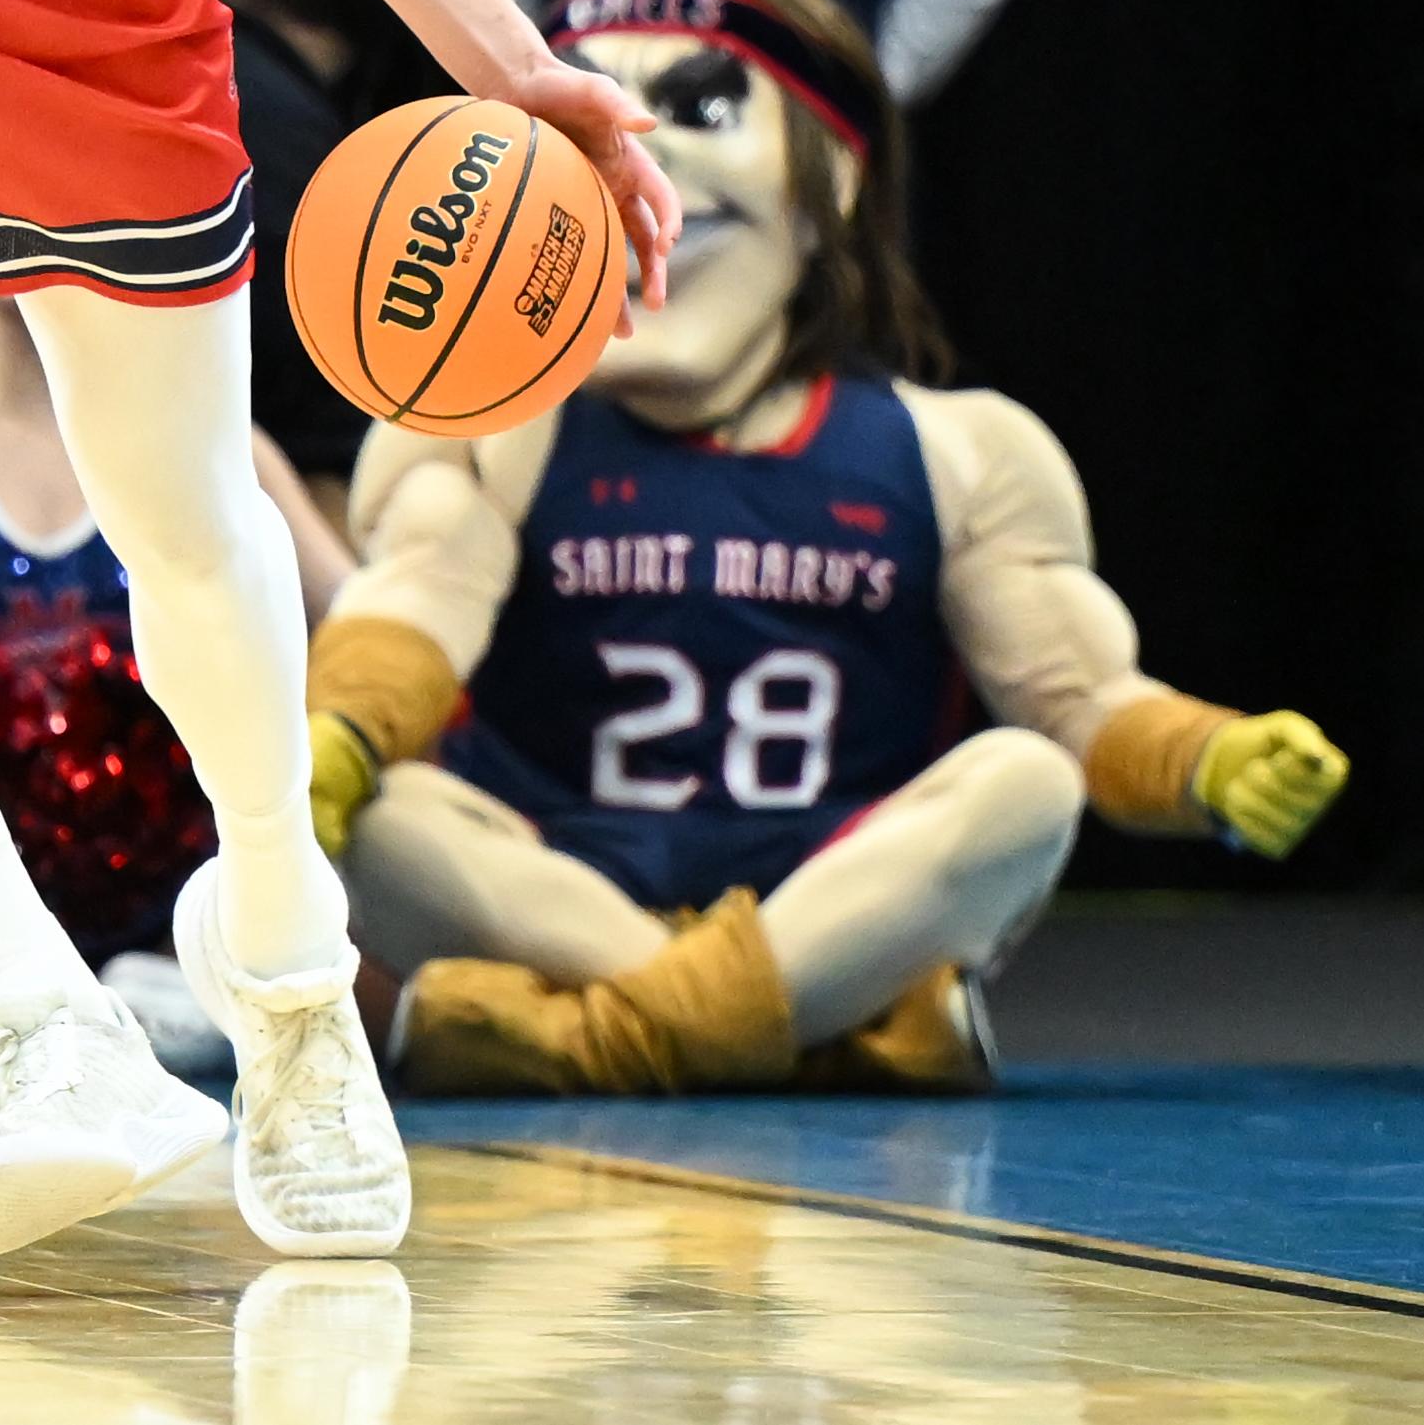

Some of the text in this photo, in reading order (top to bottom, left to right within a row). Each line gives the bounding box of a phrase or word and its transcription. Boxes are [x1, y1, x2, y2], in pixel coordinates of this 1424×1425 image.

[377, 132, 512, 331] Wilson
[474, 199, 493, 230] NXT
[525, 233, 563, 301] MARCH
[542, 215, 584, 301] MADNESS
[551, 534, 896, 612] SAINT MARY'S
[591, 641, 843, 811] 28
